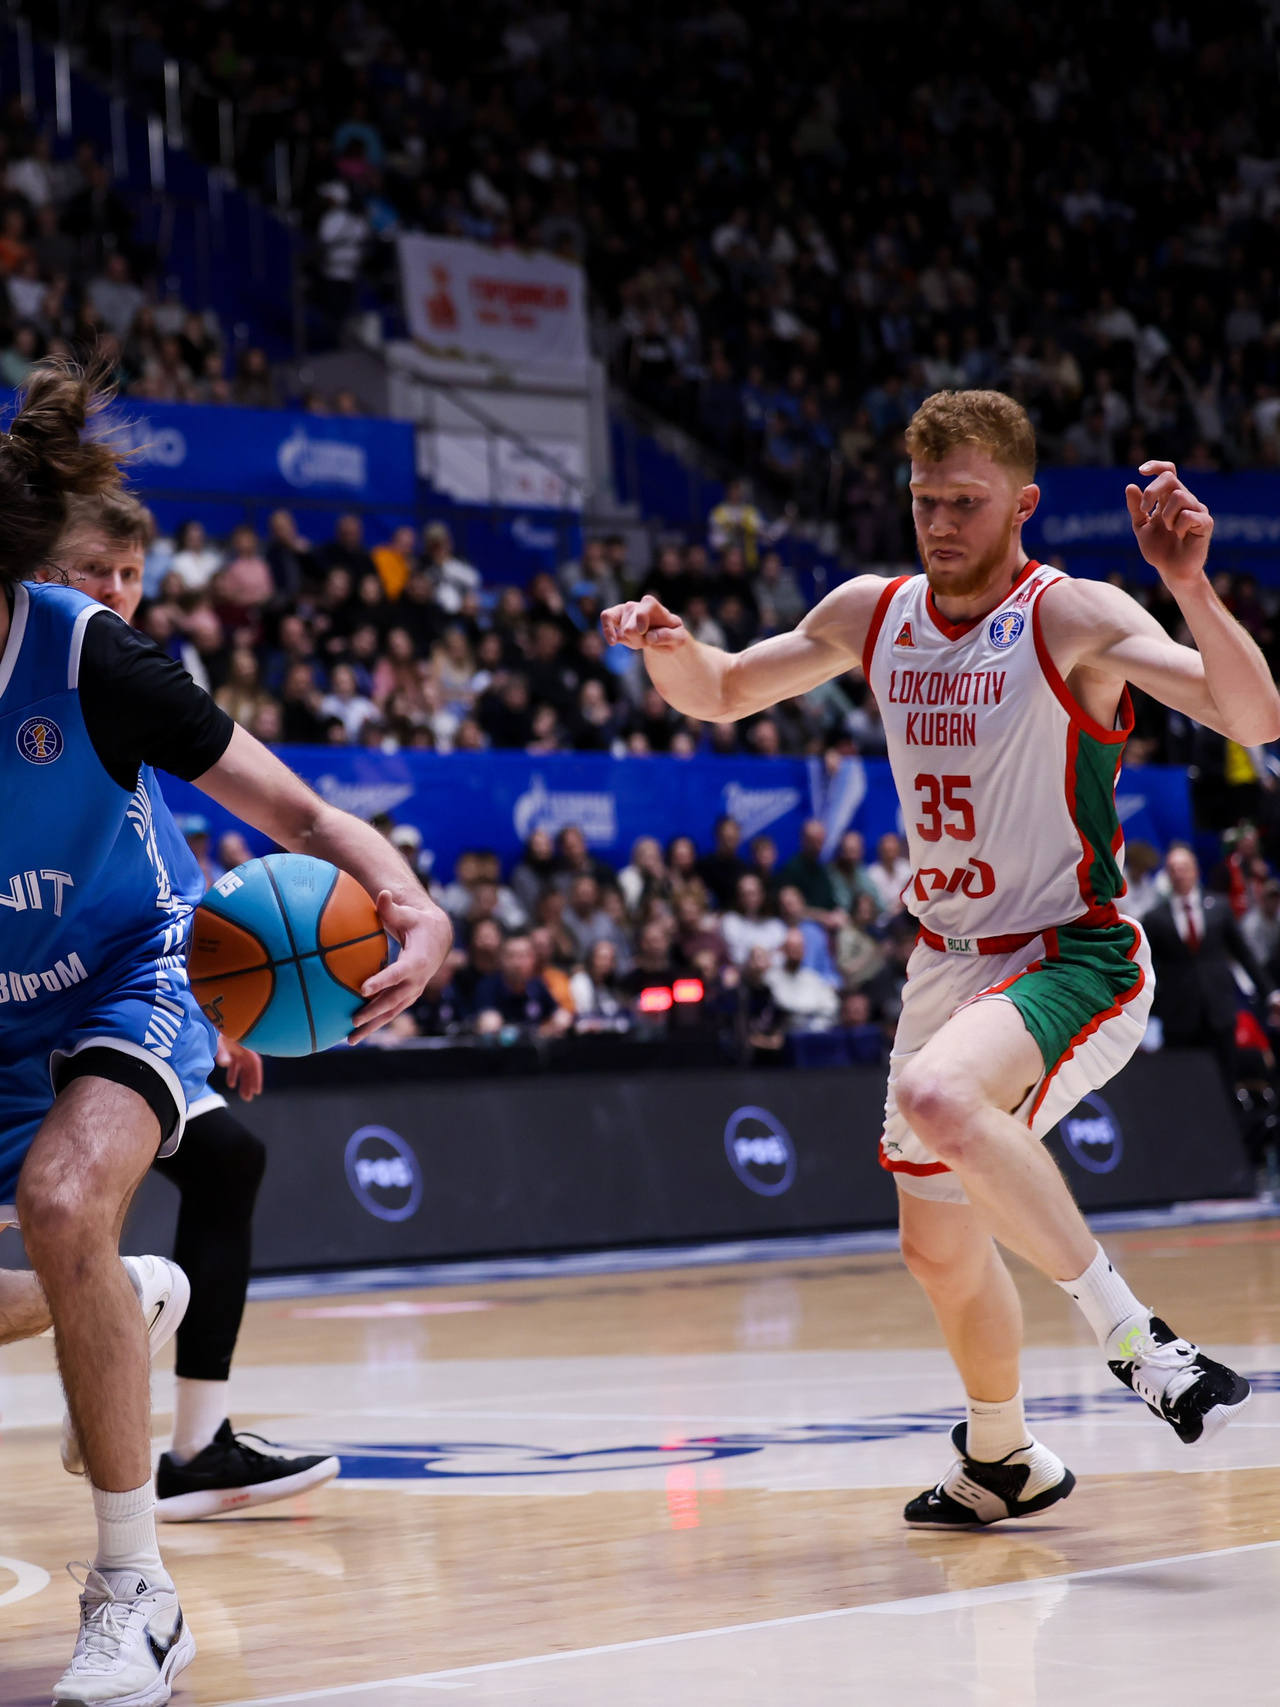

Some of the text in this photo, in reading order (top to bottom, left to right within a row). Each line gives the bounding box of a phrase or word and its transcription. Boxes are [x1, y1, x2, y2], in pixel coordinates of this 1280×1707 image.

[889, 670, 1007, 706] LOKOMOTIV
[906, 712, 977, 747] KUBAN
[914, 773, 976, 842] 35
[947, 937, 972, 952] BCLK
